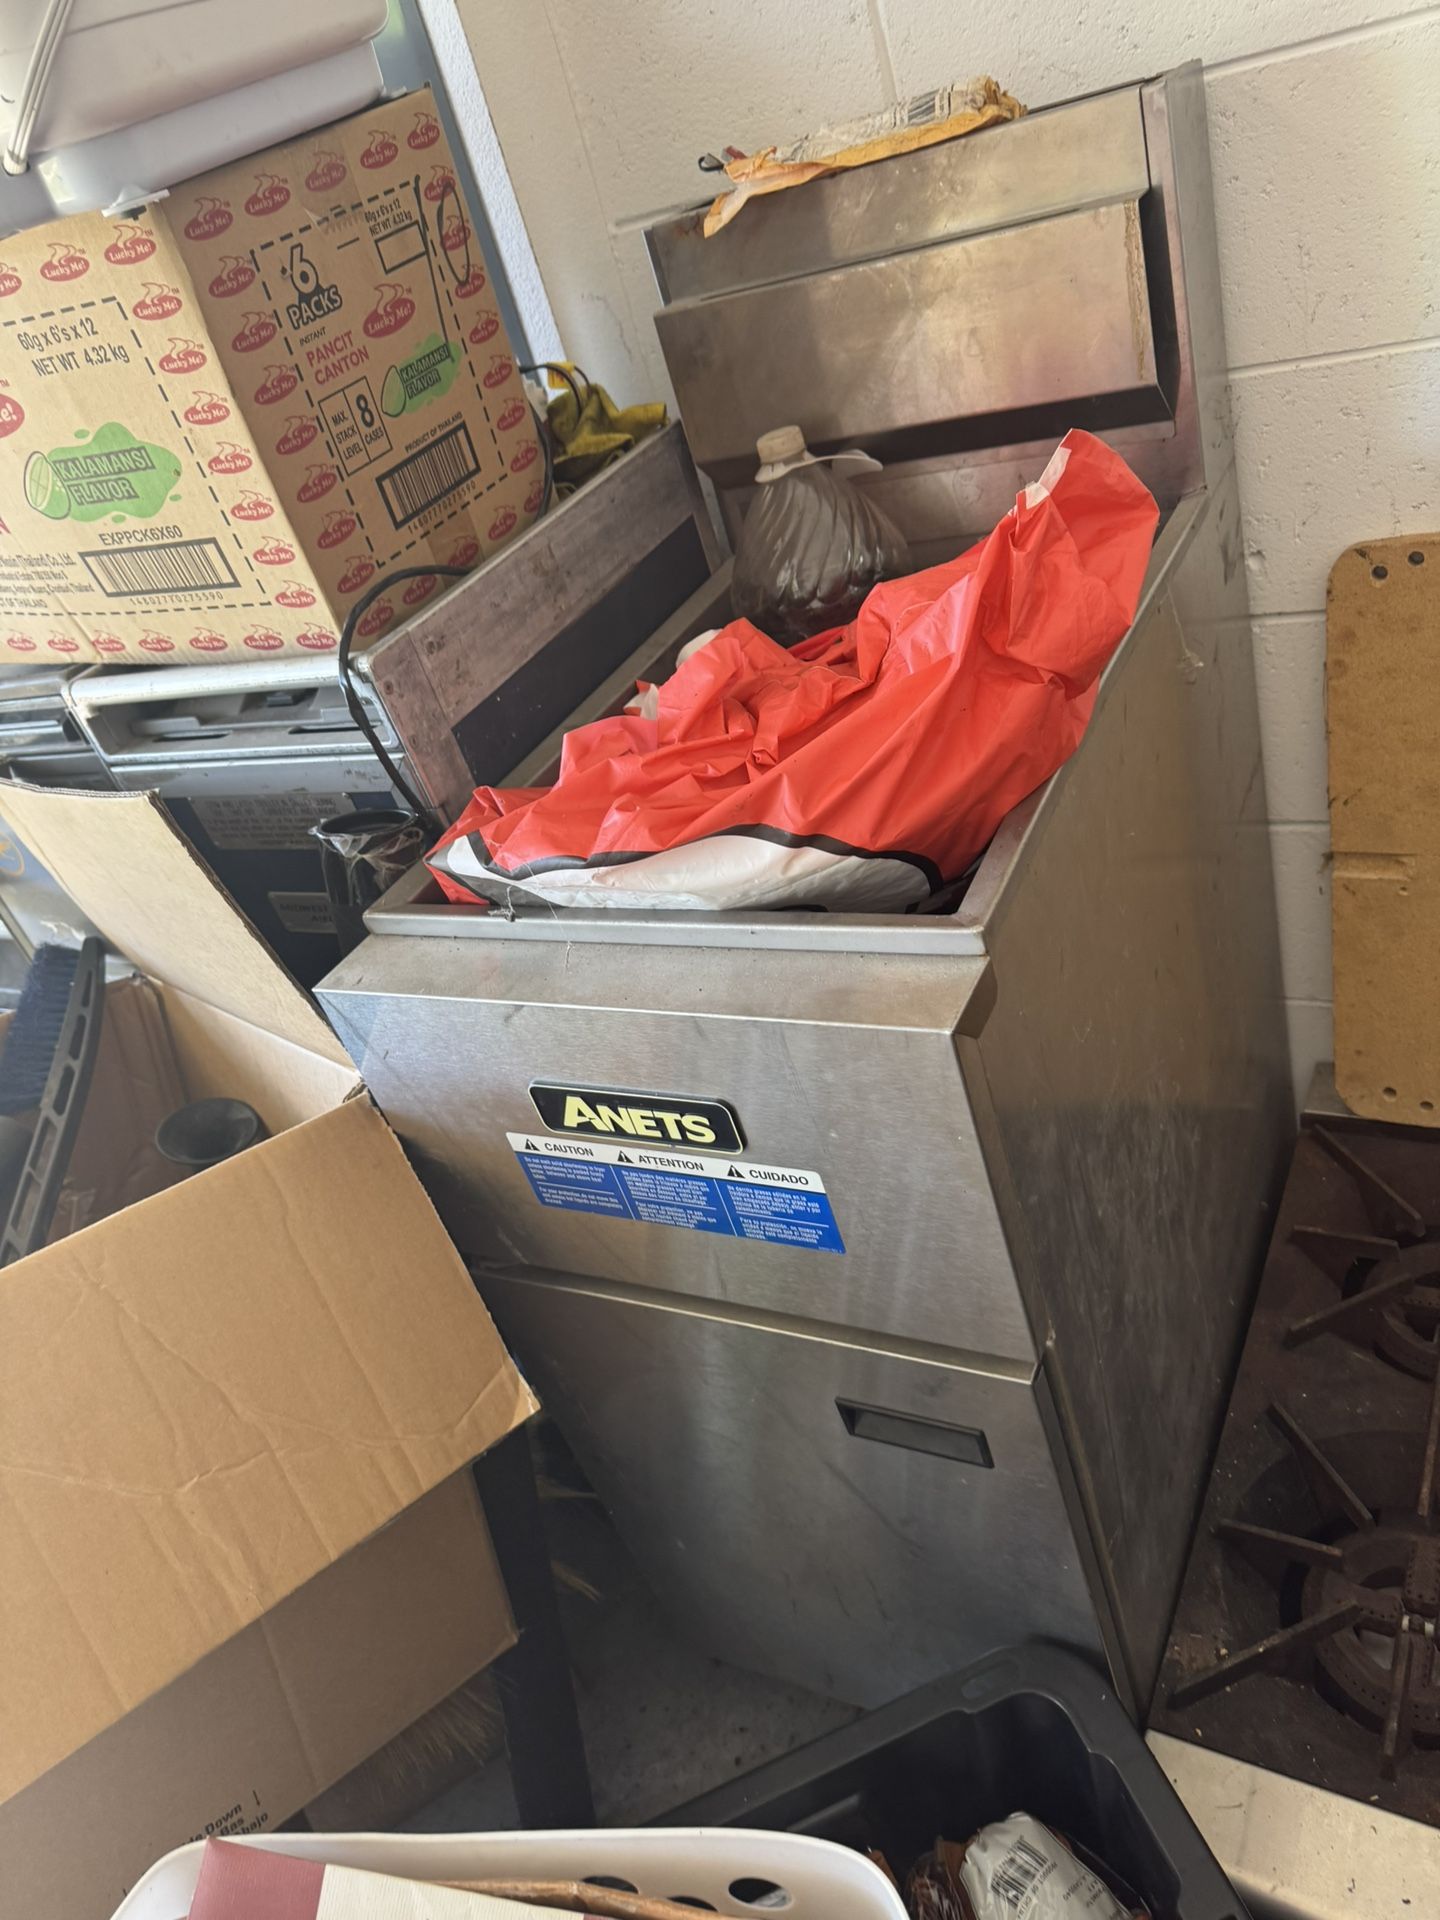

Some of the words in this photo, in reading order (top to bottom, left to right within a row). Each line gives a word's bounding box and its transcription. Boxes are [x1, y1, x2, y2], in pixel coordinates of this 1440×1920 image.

[249, 200, 272, 213] Lucky
[190, 223, 214, 237] Lucky
[109, 248, 135, 261] Lucky
[136, 242, 152, 254] Me!
[44, 264, 69, 278] Lucky
[71, 260, 85, 272] Me!
[290, 242, 319, 294] 6
[213, 279, 237, 294] Lucky
[137, 303, 162, 317] Lucky
[163, 299, 179, 311] Me!
[287, 285, 343, 330] PACKS
[368, 316, 396, 334] Lucky
[396, 304, 412, 319] Me!
[17, 332, 45, 352] 60g
[44, 330, 53, 347] x
[50, 324, 72, 344] 6's
[73, 325, 82, 340] x
[79, 317, 99, 336] 12
[236, 335, 259, 349] Lucky
[300, 327, 327, 346] INSTANT
[305, 331, 353, 369] PANCIT
[32, 355, 59, 377] NET
[56, 352, 81, 372] WT
[83, 345, 111, 367] 4.32
[108, 343, 130, 363] kg
[164, 358, 187, 371] Lucky
[188, 354, 204, 365] Me!
[315, 345, 370, 385] CANTON
[400, 343, 450, 385] KALAMANSI
[405, 368, 441, 400] FLAVOR
[258, 388, 281, 402] Lucky
[0, 402, 17, 422] e!
[188, 410, 212, 422] Lucky
[212, 407, 226, 418] Me!
[332, 410, 350, 426] MAX
[356, 394, 375, 428] 8
[335, 425, 358, 444] STACK
[364, 427, 385, 445] CASES
[404, 431, 430, 453] PRODUCT
[430, 427, 437, 437] OF
[437, 411, 463, 431] THAILAND
[280, 439, 302, 452] Lucky
[343, 442, 364, 461] LEVEL
[53, 446, 156, 481] KALAMANSI
[211, 460, 235, 471] Lucky
[235, 457, 249, 467] Me!
[67, 477, 140, 506] FLAVOR
[234, 506, 257, 517] Lucky
[98, 525, 183, 546] EXPPCK6X60
[257, 552, 280, 562] Lucky
[278, 595, 301, 606] Lucky
[300, 635, 321, 647] Lucky
[563, 1096, 716, 1144] ANETS
[544, 1141, 594, 1158] CAUTION
[638, 1154, 705, 1172] ATTENTION
[749, 1168, 810, 1186] CUIDADO
[204, 1804, 242, 1835] Down
